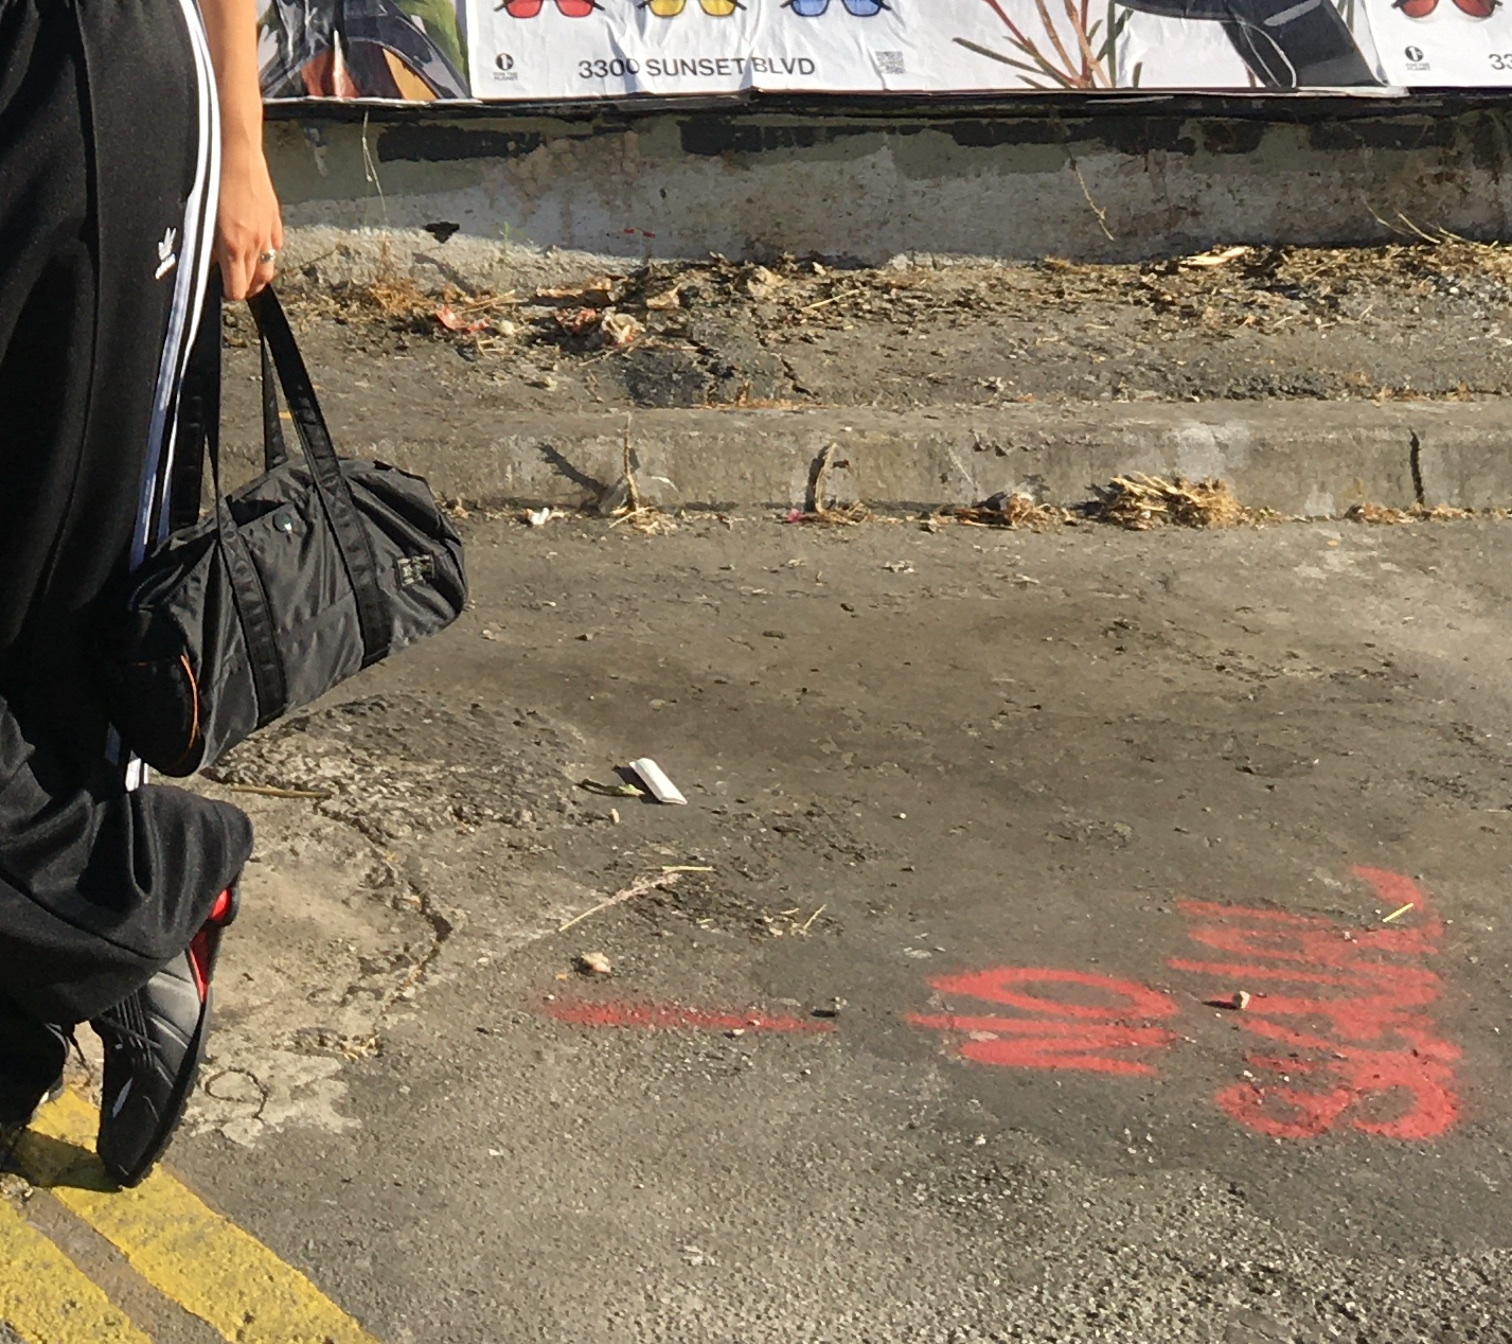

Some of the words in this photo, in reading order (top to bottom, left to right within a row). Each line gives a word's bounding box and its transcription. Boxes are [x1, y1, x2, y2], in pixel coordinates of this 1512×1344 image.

[578, 58, 640, 79] 3300
[645, 57, 746, 77] SUNSET
[751, 57, 816, 76] BLVD
